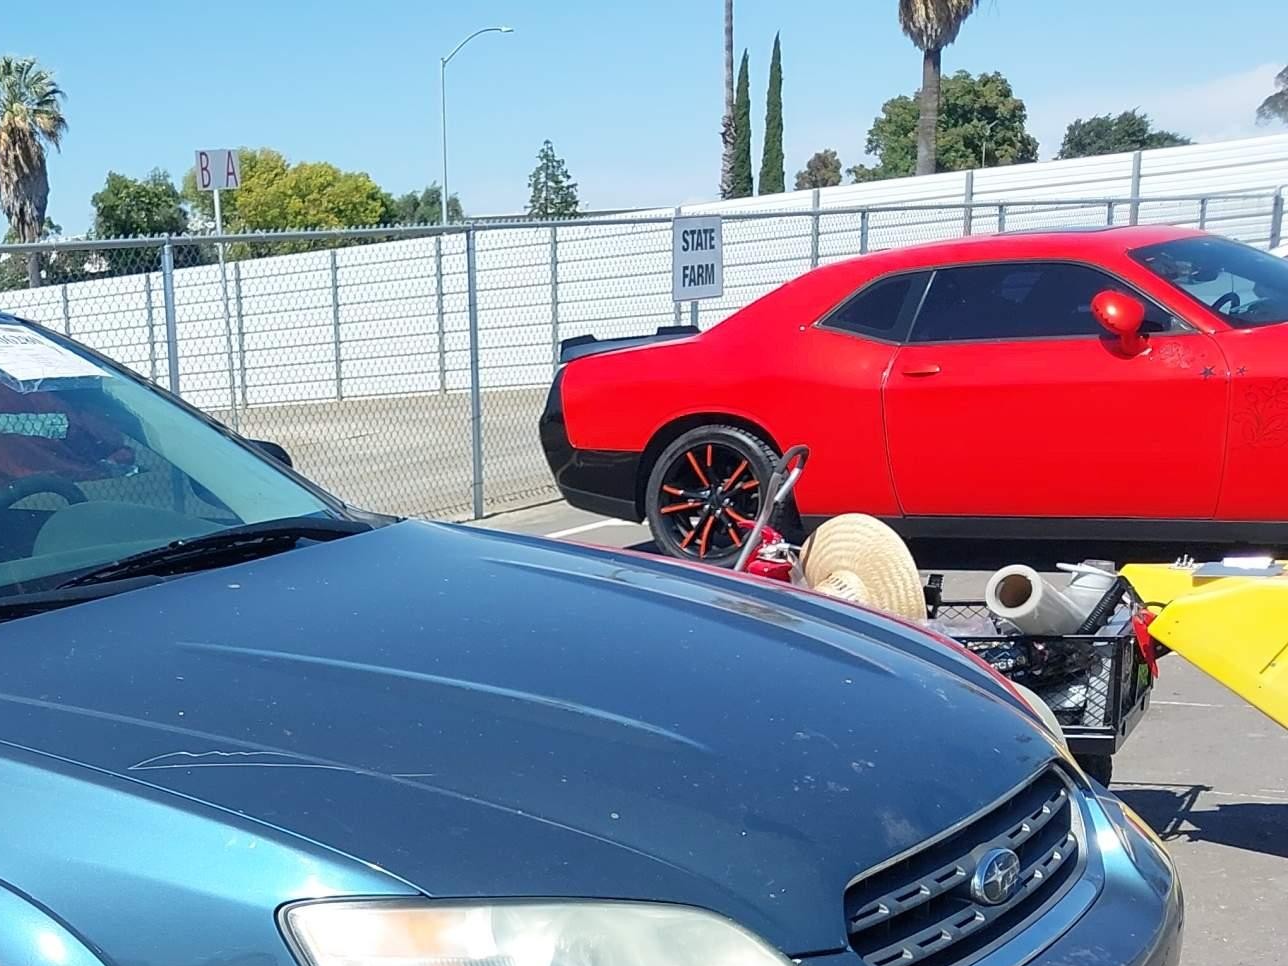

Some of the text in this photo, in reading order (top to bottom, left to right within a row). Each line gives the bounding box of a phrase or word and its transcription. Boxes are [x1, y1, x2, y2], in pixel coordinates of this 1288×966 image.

[199, 150, 239, 188] B A
[681, 228, 715, 252] STATE
[682, 263, 715, 288] FARM
